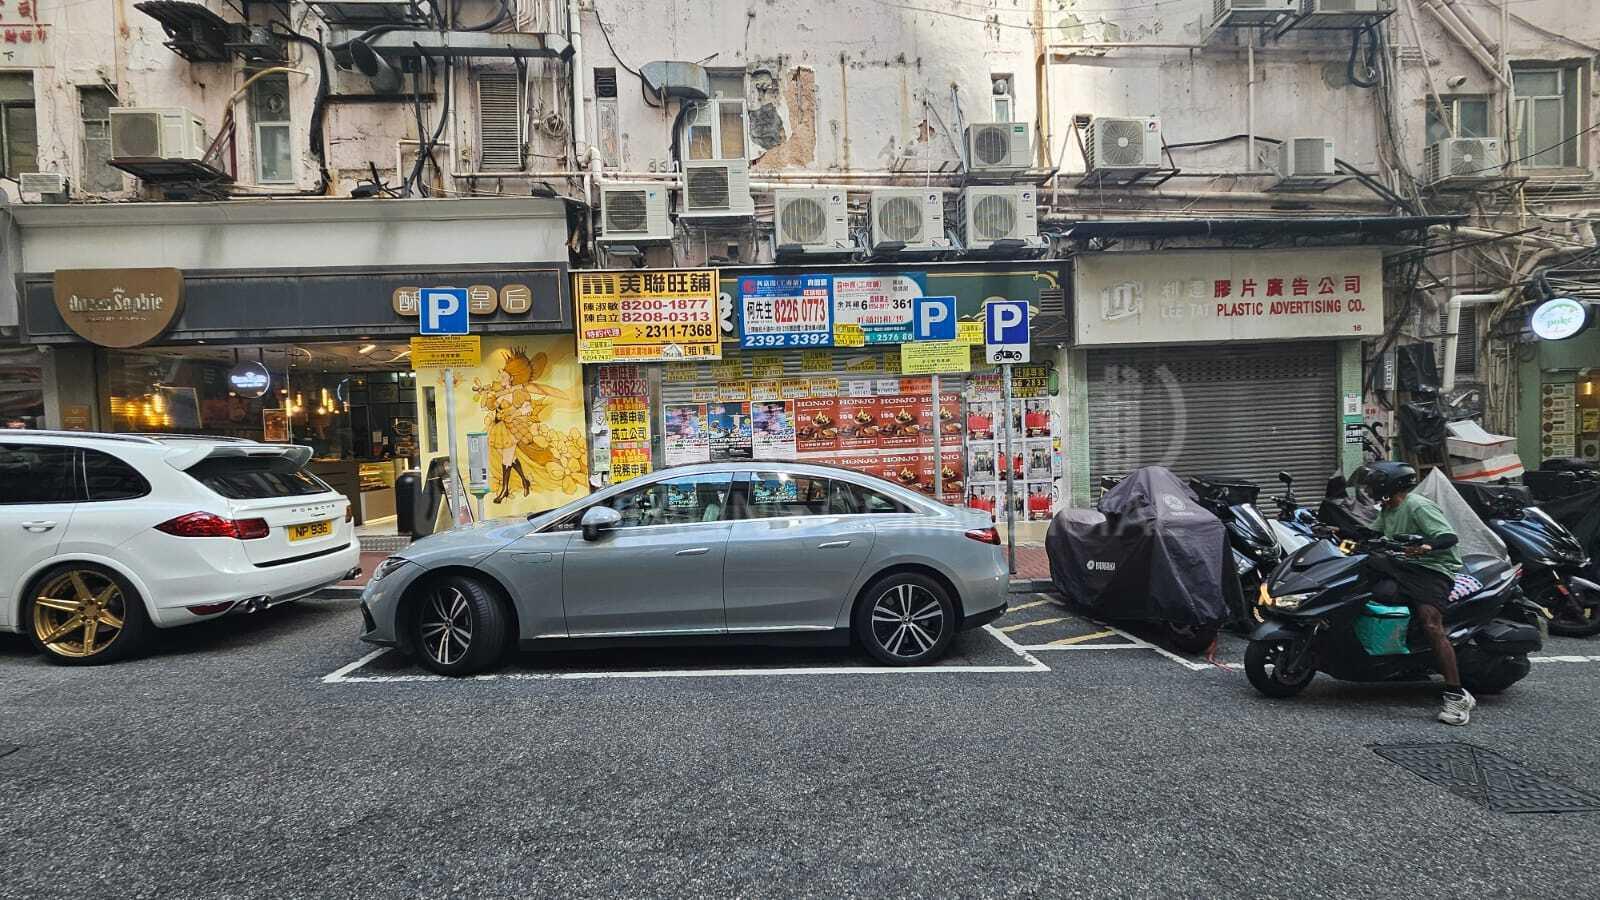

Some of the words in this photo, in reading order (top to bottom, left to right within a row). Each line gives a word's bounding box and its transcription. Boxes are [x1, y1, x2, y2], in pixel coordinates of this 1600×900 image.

[620, 273, 711, 293] 美聯旺舖
[428, 293, 459, 329] P
[621, 300, 708, 310] 8200-1877
[747, 301, 772, 320] 何先生
[774, 300, 799, 323] 8226
[801, 299, 826, 323] 0773
[1217, 302, 1263, 316] PLASTIC
[1269, 299, 1341, 315] ADVERTISING
[1347, 298, 1366, 312] CO.
[621, 312, 710, 322] 8208-0313
[920, 301, 948, 337] P
[993, 303, 1022, 341] P
[645, 324, 712, 338] 2311-7368
[745, 335, 785, 347] 2392
[790, 333, 829, 345] 3392
[600, 380, 648, 396] 55486228
[880, 397, 917, 405] HONJO
[612, 427, 647, 440] 成立公司
[882, 455, 919, 463] HONJO
[295, 526, 309, 538] NP
